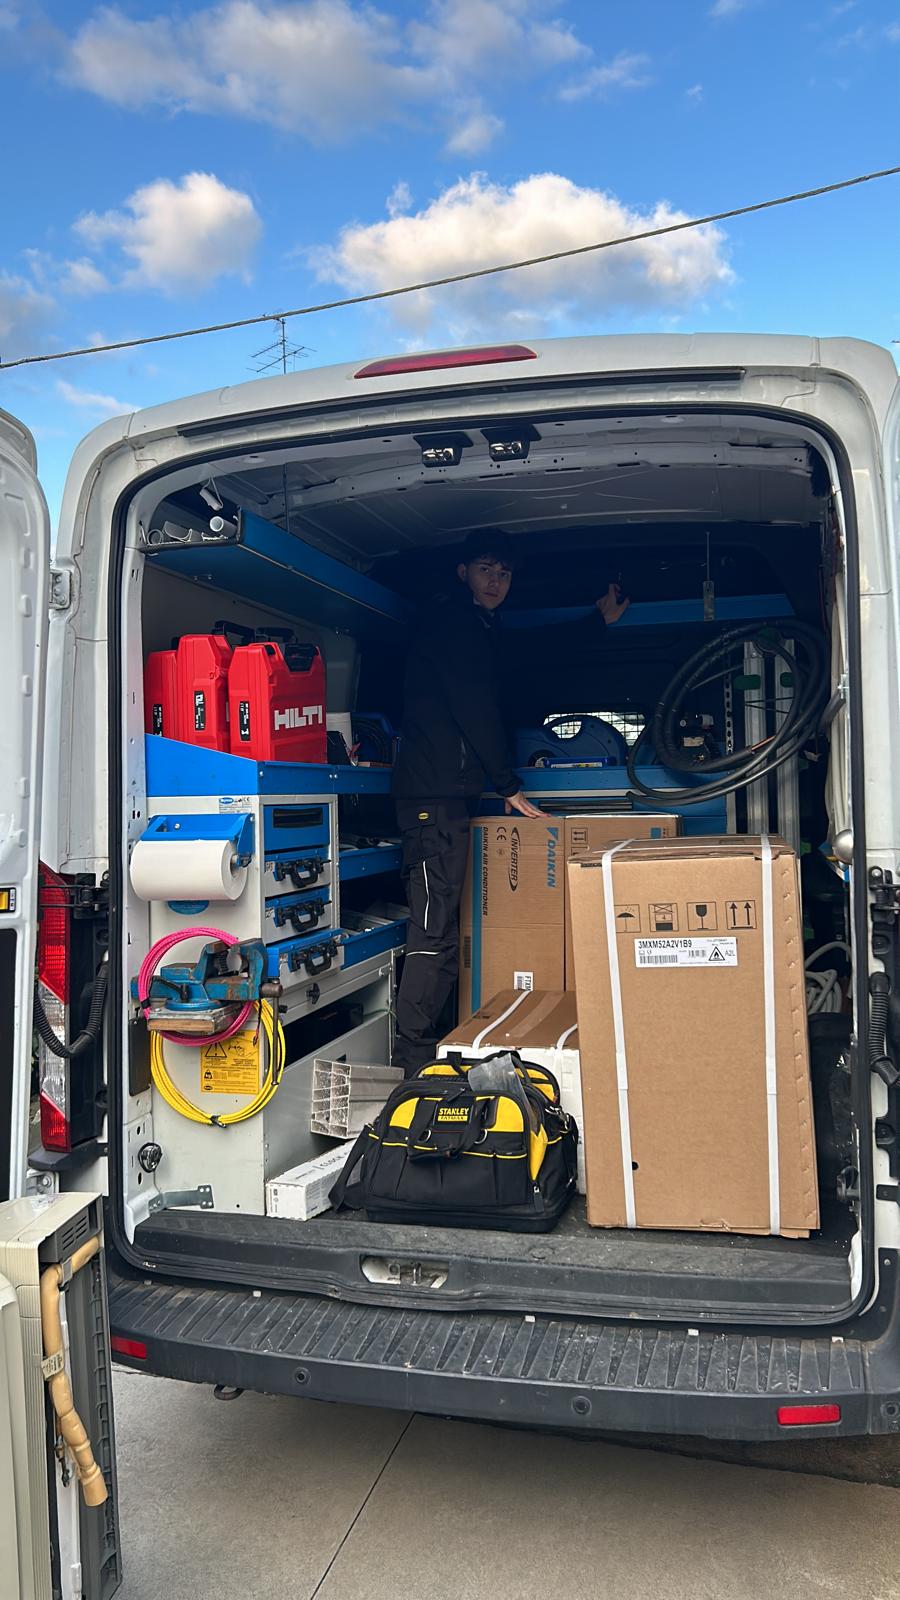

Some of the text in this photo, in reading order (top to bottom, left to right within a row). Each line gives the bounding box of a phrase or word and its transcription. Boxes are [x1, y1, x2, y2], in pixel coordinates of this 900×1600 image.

[274, 705, 323, 731] HILTI
[510, 838, 518, 881] INVERTER
[547, 839, 556, 888] DAIKIN
[638, 939, 692, 949] 3MXM52A2V1B9
[438, 1107, 470, 1115] STANLEY
